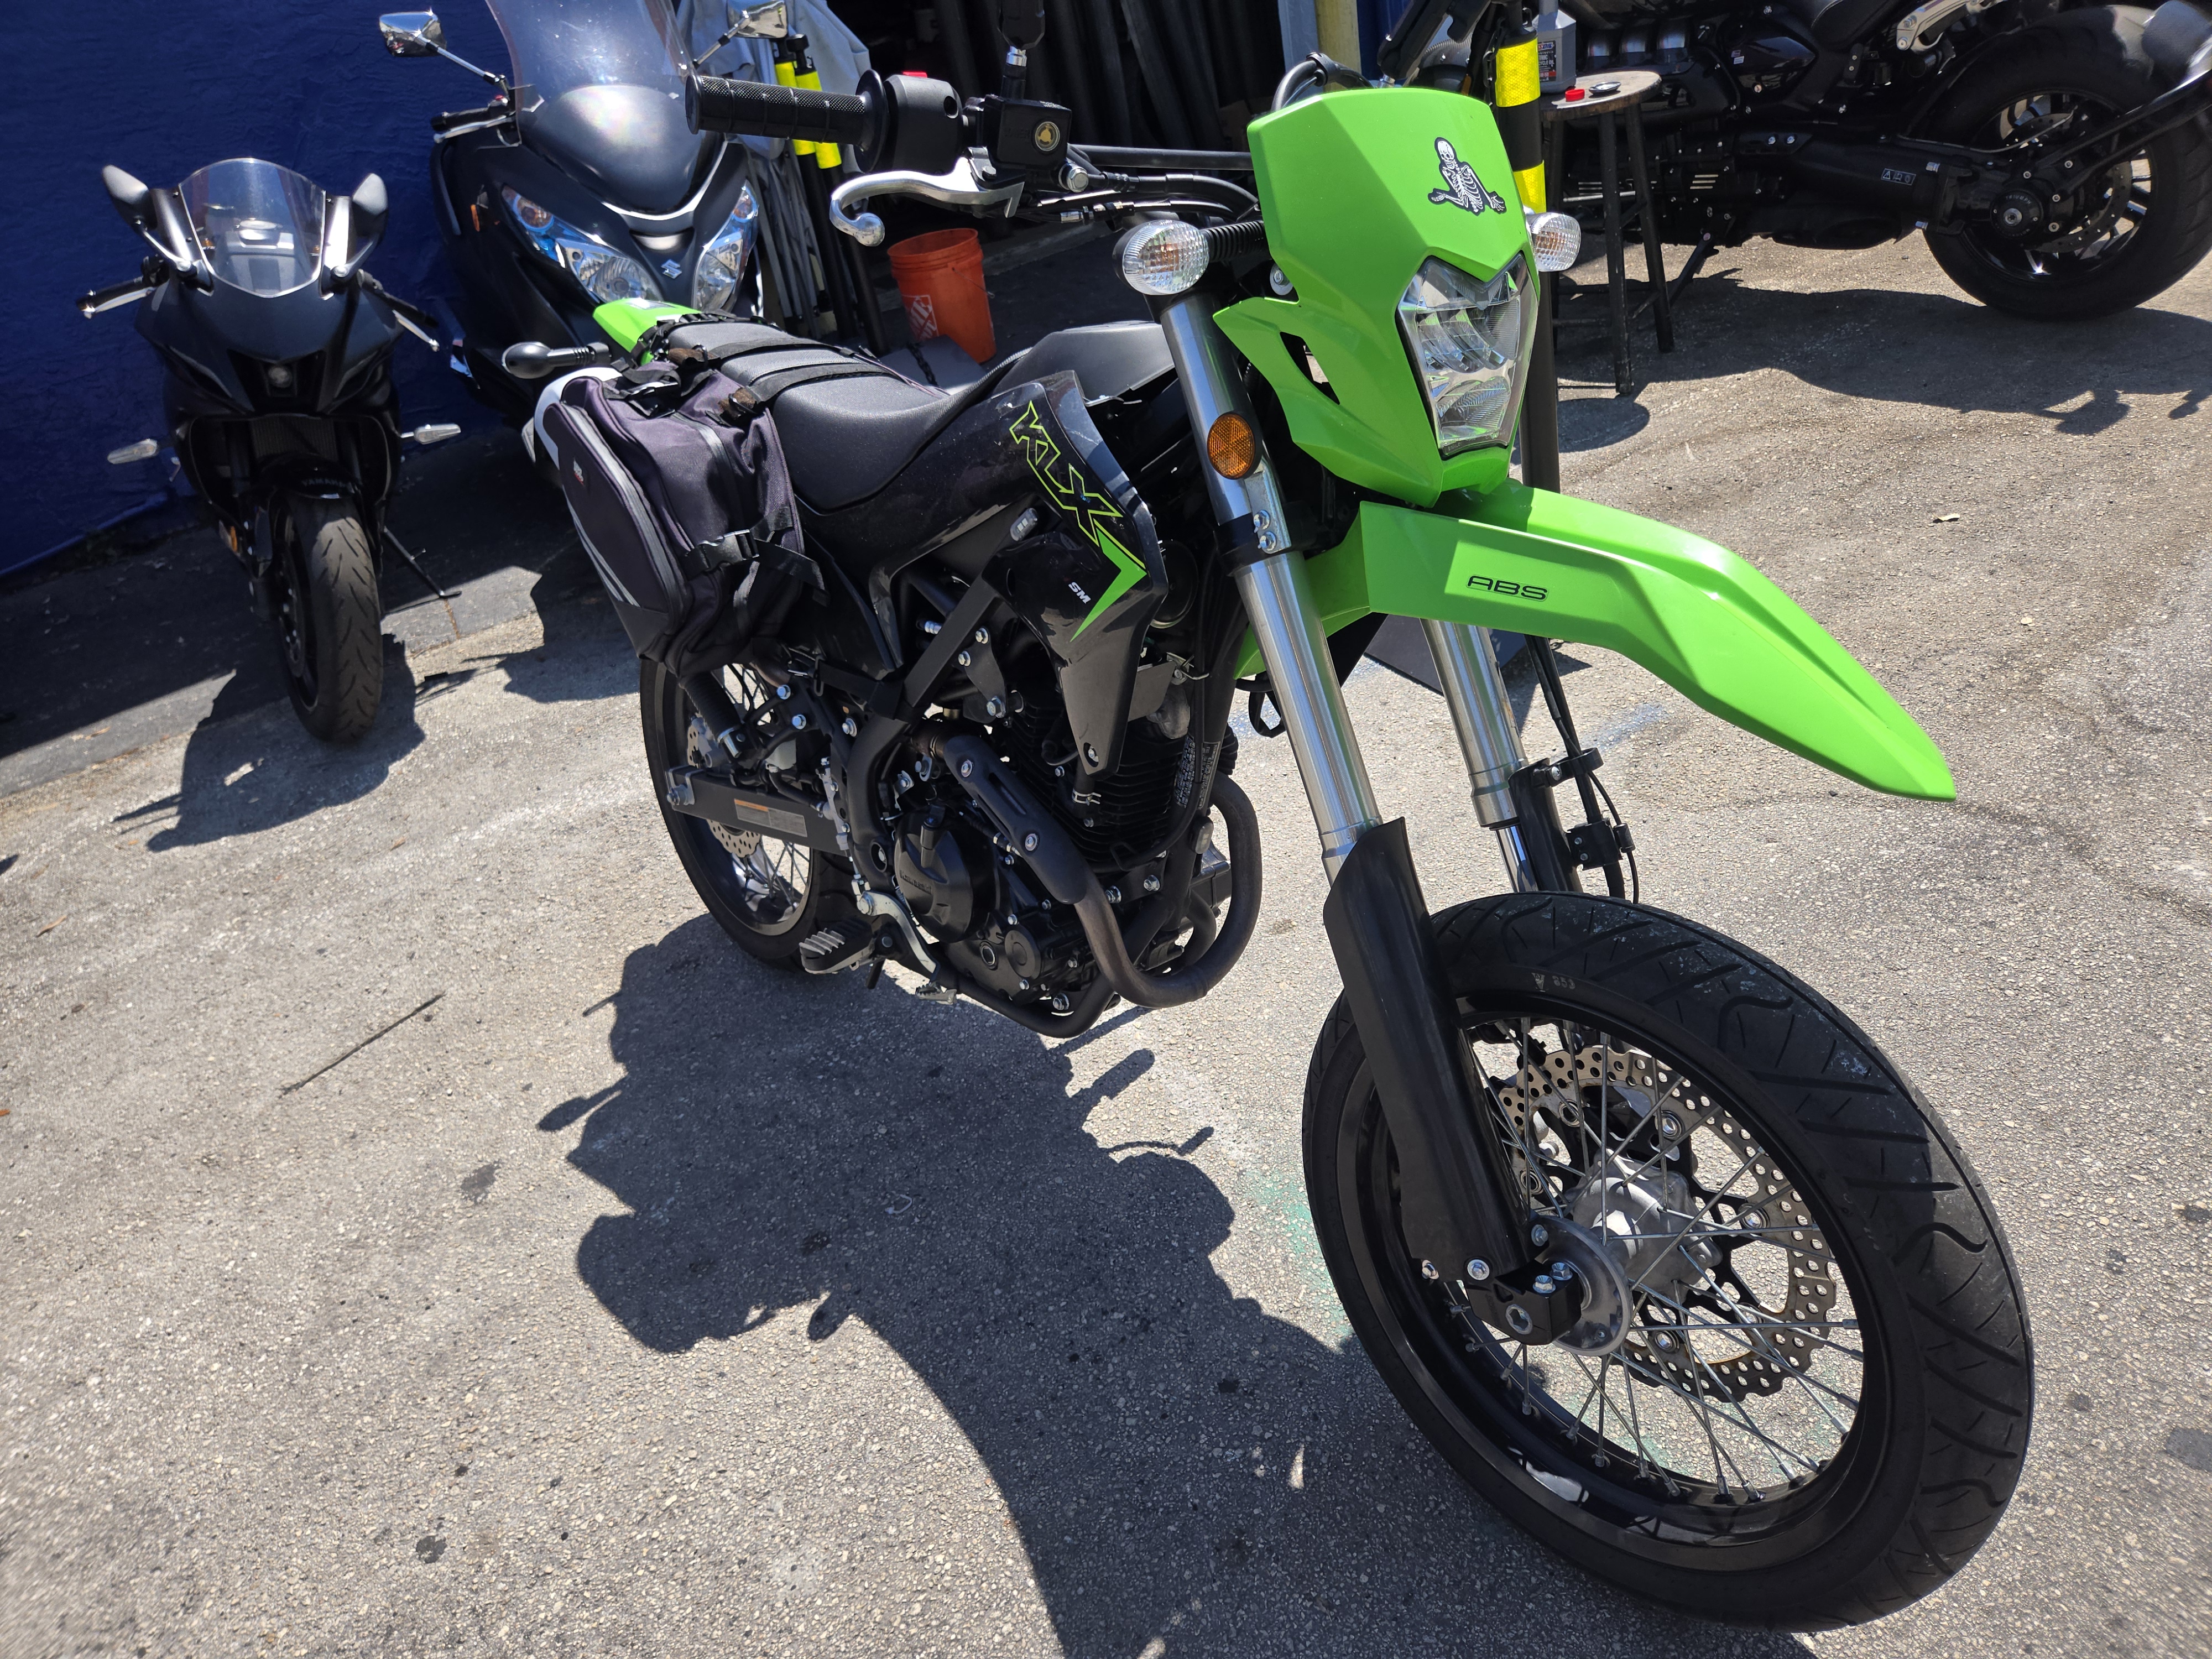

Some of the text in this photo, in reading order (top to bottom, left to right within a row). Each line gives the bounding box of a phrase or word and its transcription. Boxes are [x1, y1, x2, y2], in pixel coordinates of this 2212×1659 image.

[2005, 194, 2032, 205] TRIUMPH
[1009, 400, 1123, 547] KLX
[1068, 582, 1092, 604] SM
[1467, 575, 1548, 600] ABS
